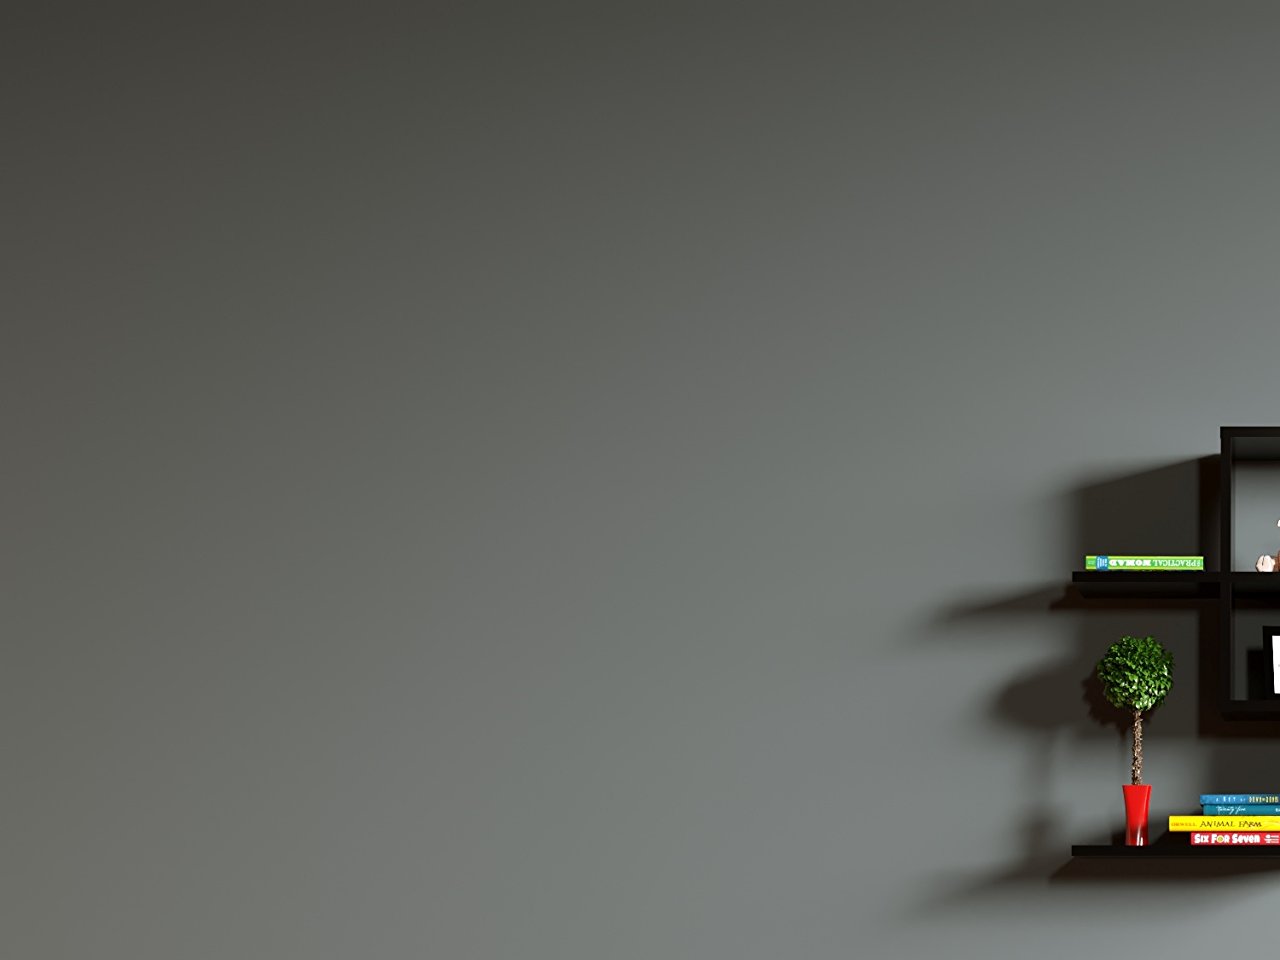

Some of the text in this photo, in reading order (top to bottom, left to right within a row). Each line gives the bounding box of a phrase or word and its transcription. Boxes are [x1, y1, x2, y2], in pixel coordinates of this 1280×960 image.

[1109, 559, 1151, 567] NOMAD
[1153, 559, 1197, 567] PRACTICAL
[1200, 820, 1235, 828] ANIMAL
[1239, 820, 1262, 828] FARM
